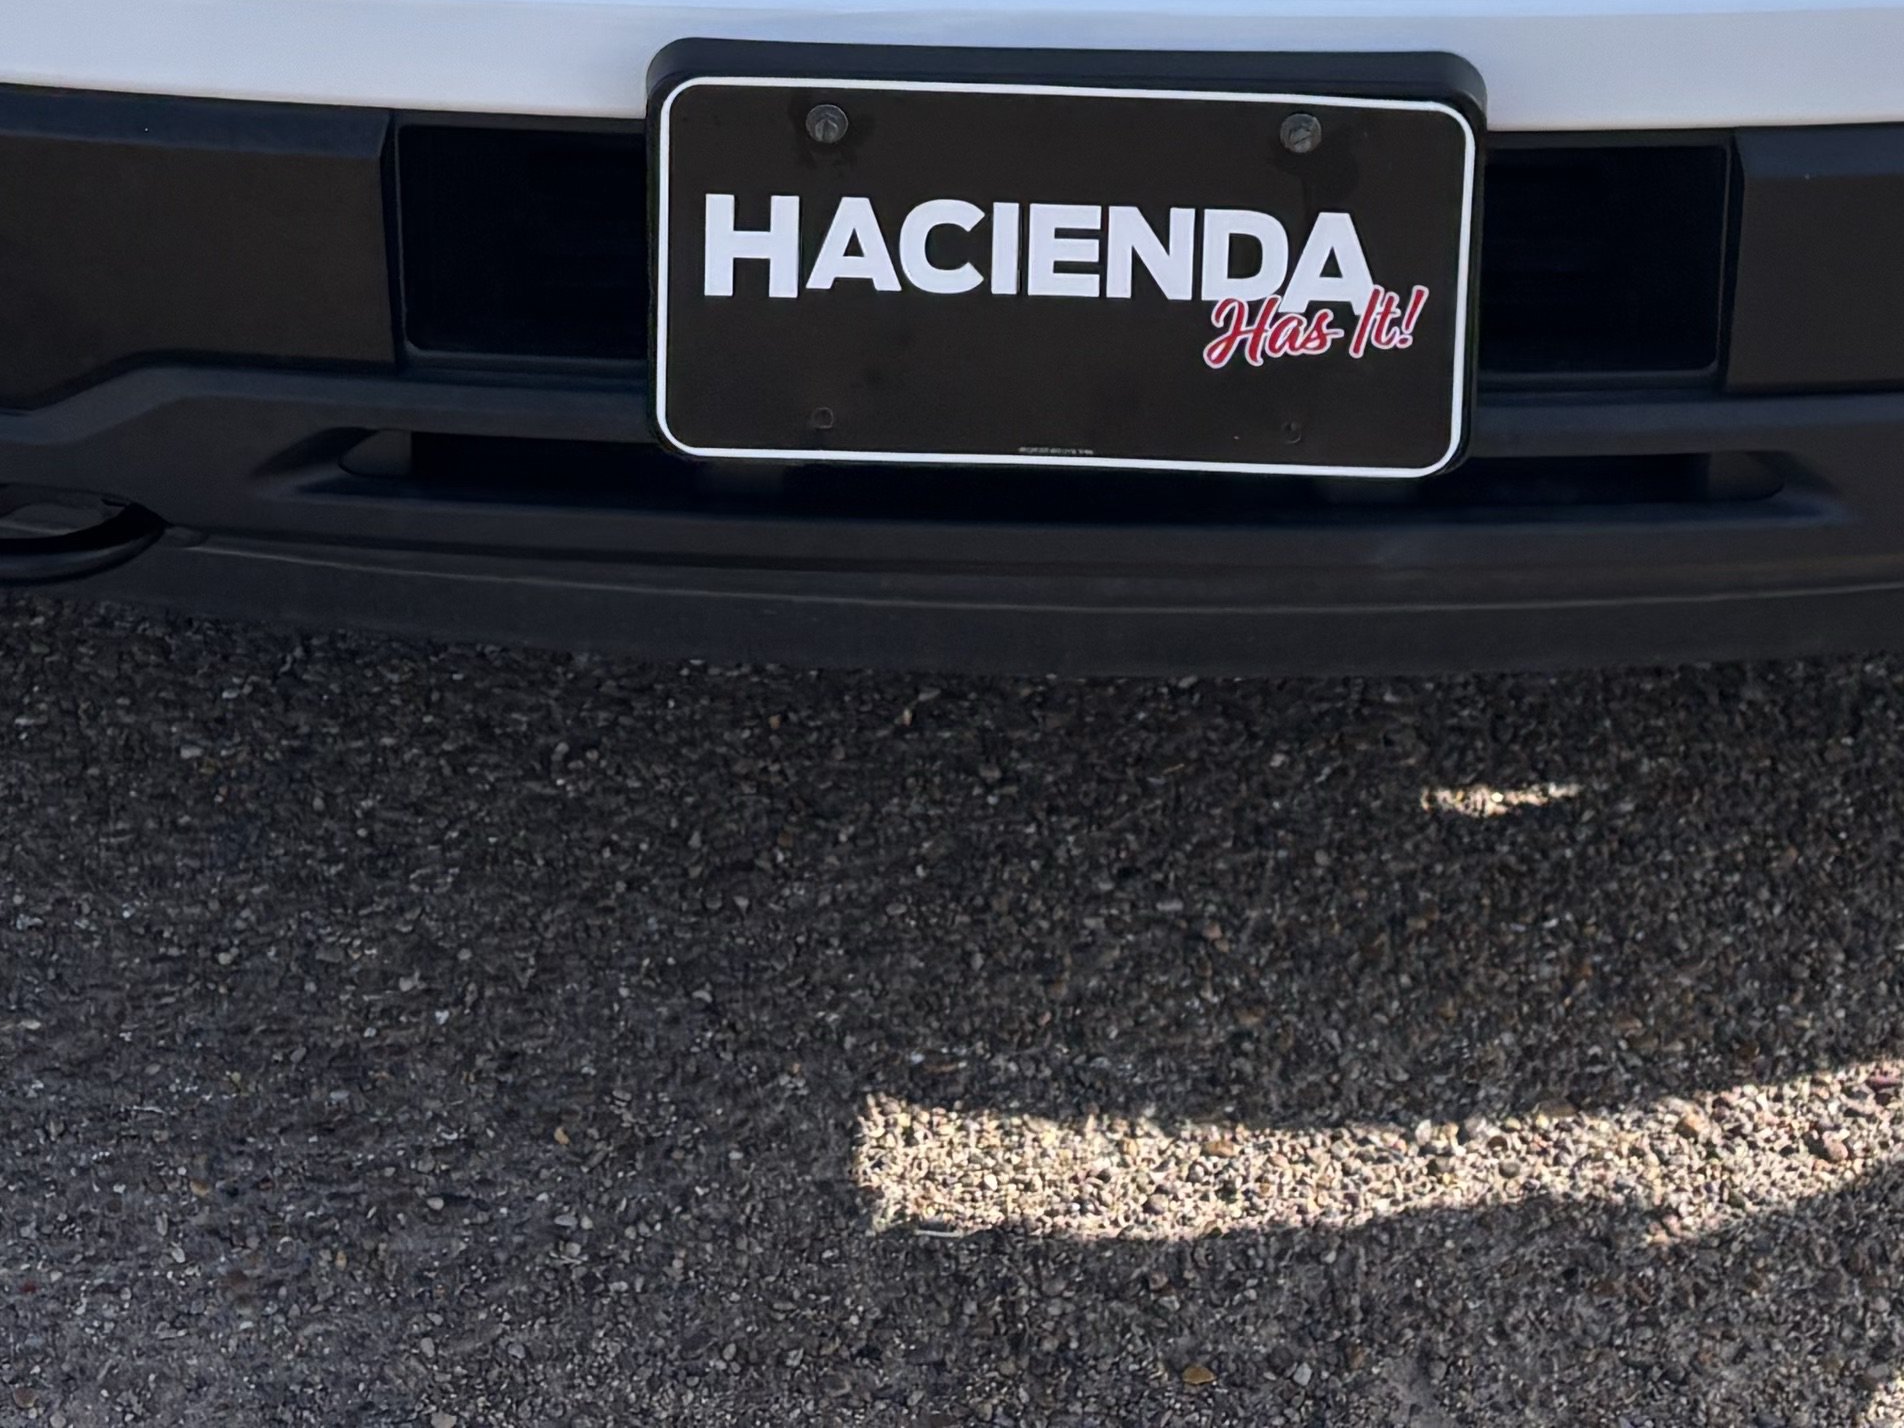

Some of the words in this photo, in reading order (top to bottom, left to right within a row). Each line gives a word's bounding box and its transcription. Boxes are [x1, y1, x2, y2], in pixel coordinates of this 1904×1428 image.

[704, 192, 1376, 316] HACIENDA
[1203, 294, 1345, 369] Has
[1349, 284, 1430, 359] It!
